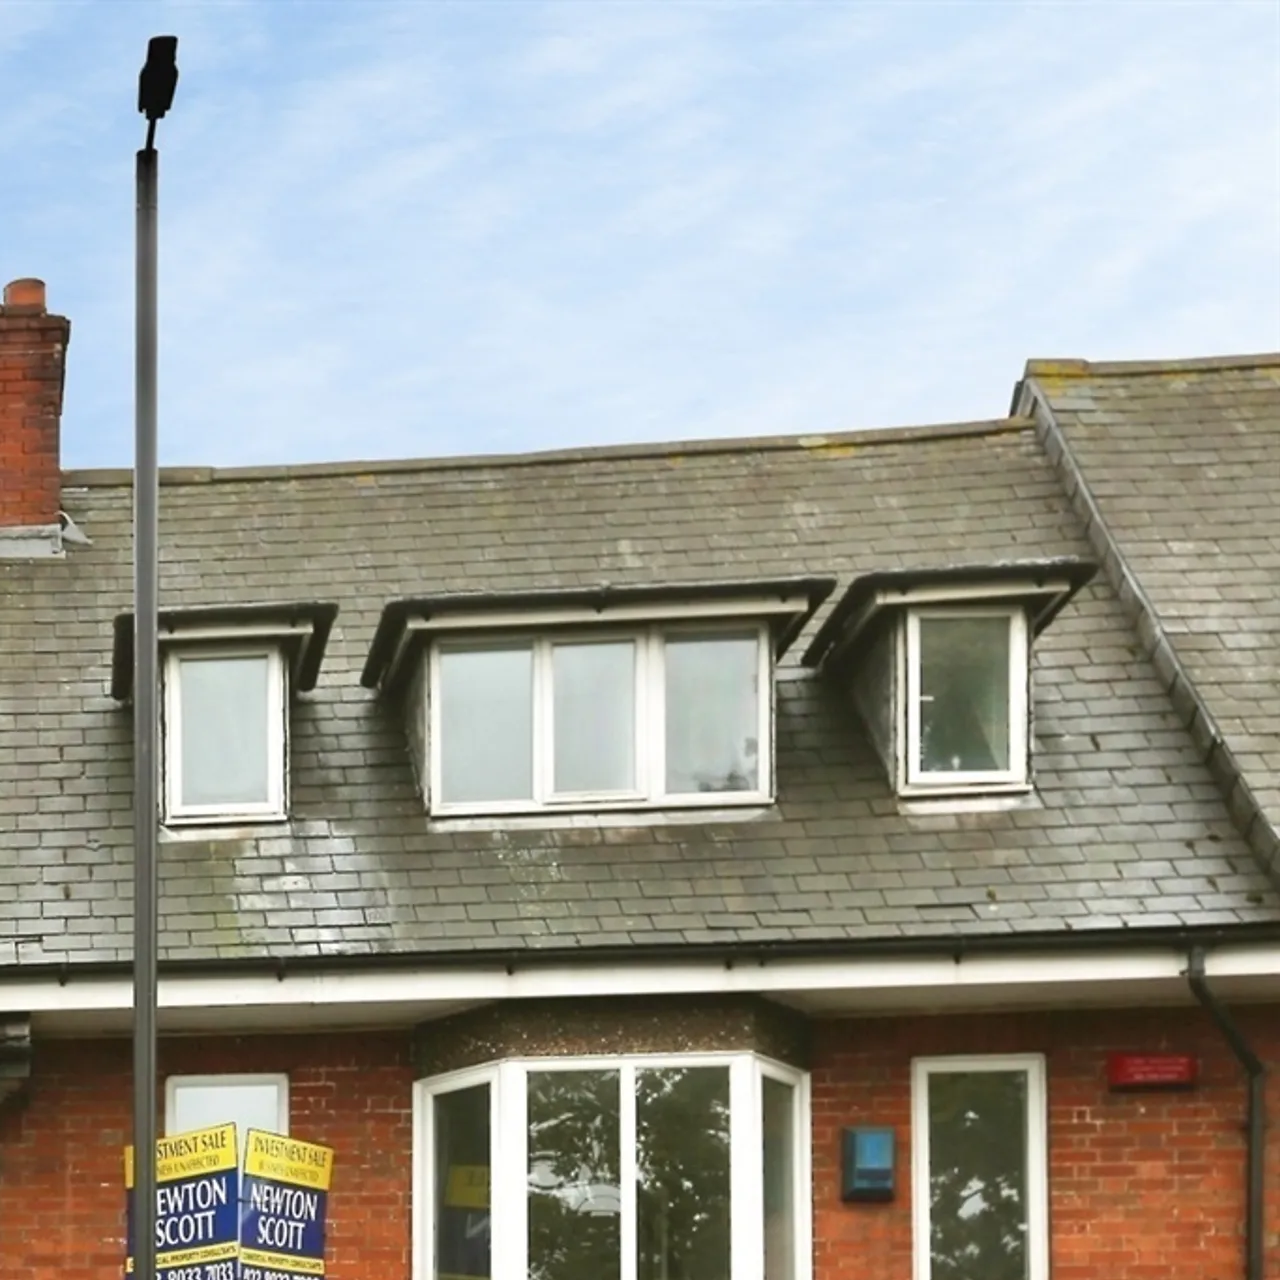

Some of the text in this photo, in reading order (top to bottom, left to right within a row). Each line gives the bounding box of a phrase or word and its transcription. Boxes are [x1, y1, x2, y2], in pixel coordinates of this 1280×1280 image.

[157, 1130, 226, 1161] STMENT SALE
[156, 1177, 226, 1216] EWTON
[251, 1183, 318, 1221] NEWTON
[156, 1211, 216, 1248] SCOTT
[257, 1215, 306, 1250] SCOTT
